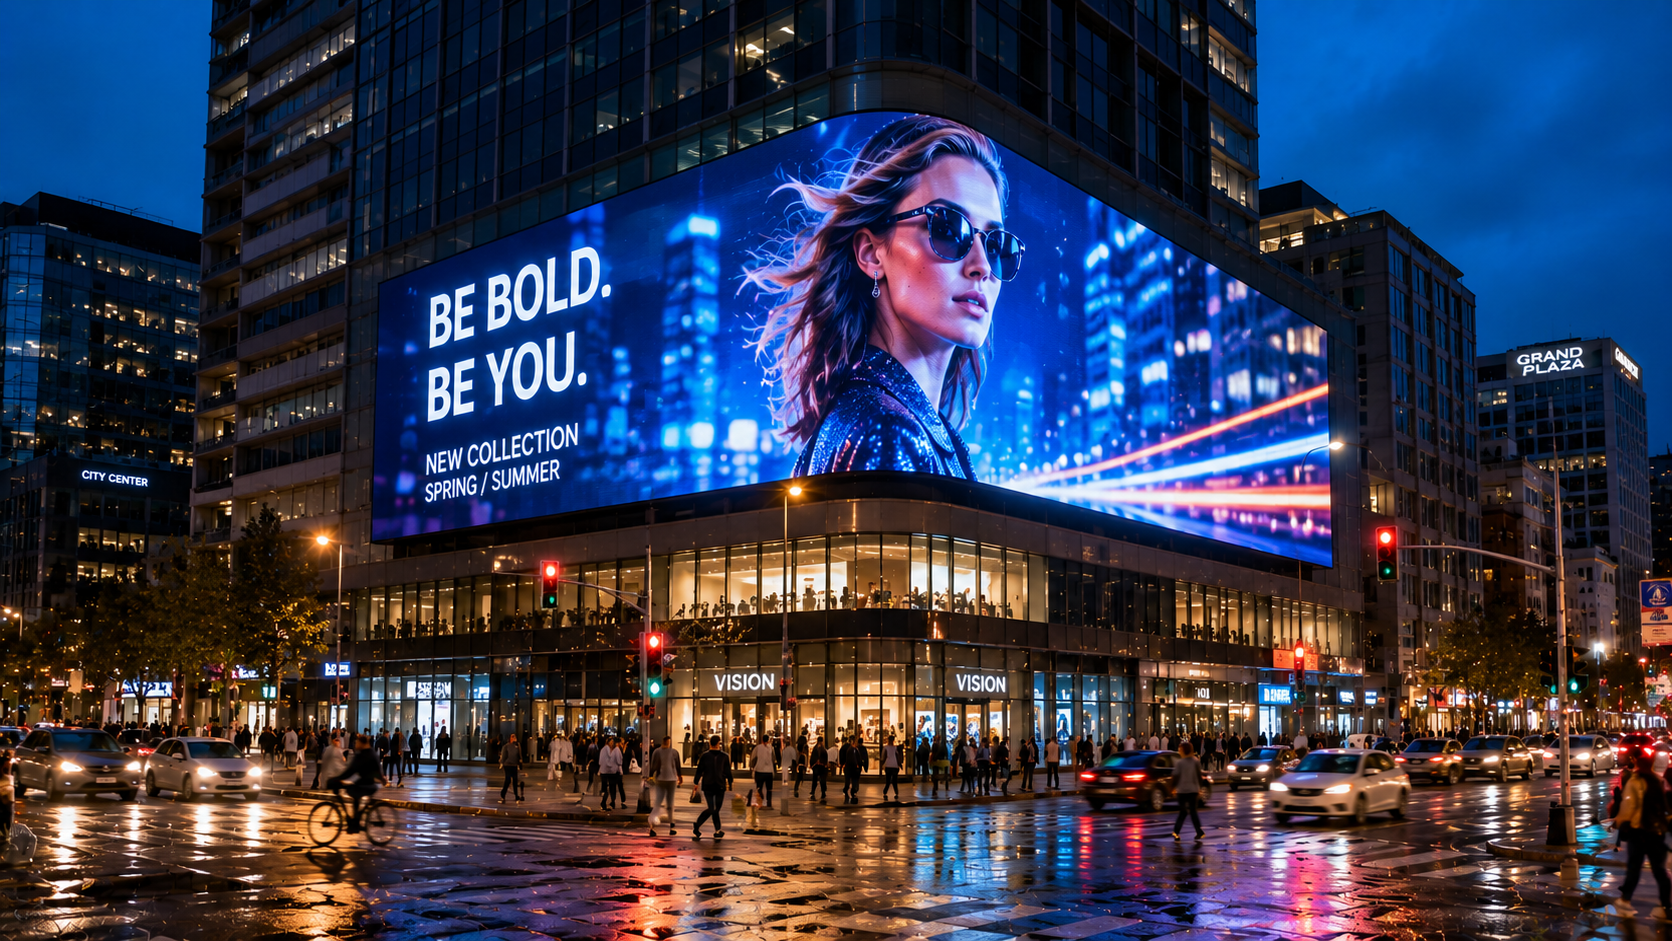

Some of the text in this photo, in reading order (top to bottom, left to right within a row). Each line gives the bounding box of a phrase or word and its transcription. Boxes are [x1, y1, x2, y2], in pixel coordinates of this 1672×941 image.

[429, 246, 611, 349] BE BOLD.
[1516, 347, 1583, 365] GRAND
[427, 331, 587, 422] BE YOU.
[1522, 358, 1585, 376] PLAZA
[426, 422, 579, 476] NEW COLLECTION
[81, 470, 148, 487] CITY CENTER
[425, 459, 560, 503] SPRING / SUMMER
[714, 673, 775, 691] VISION
[956, 673, 1006, 693] VISION
